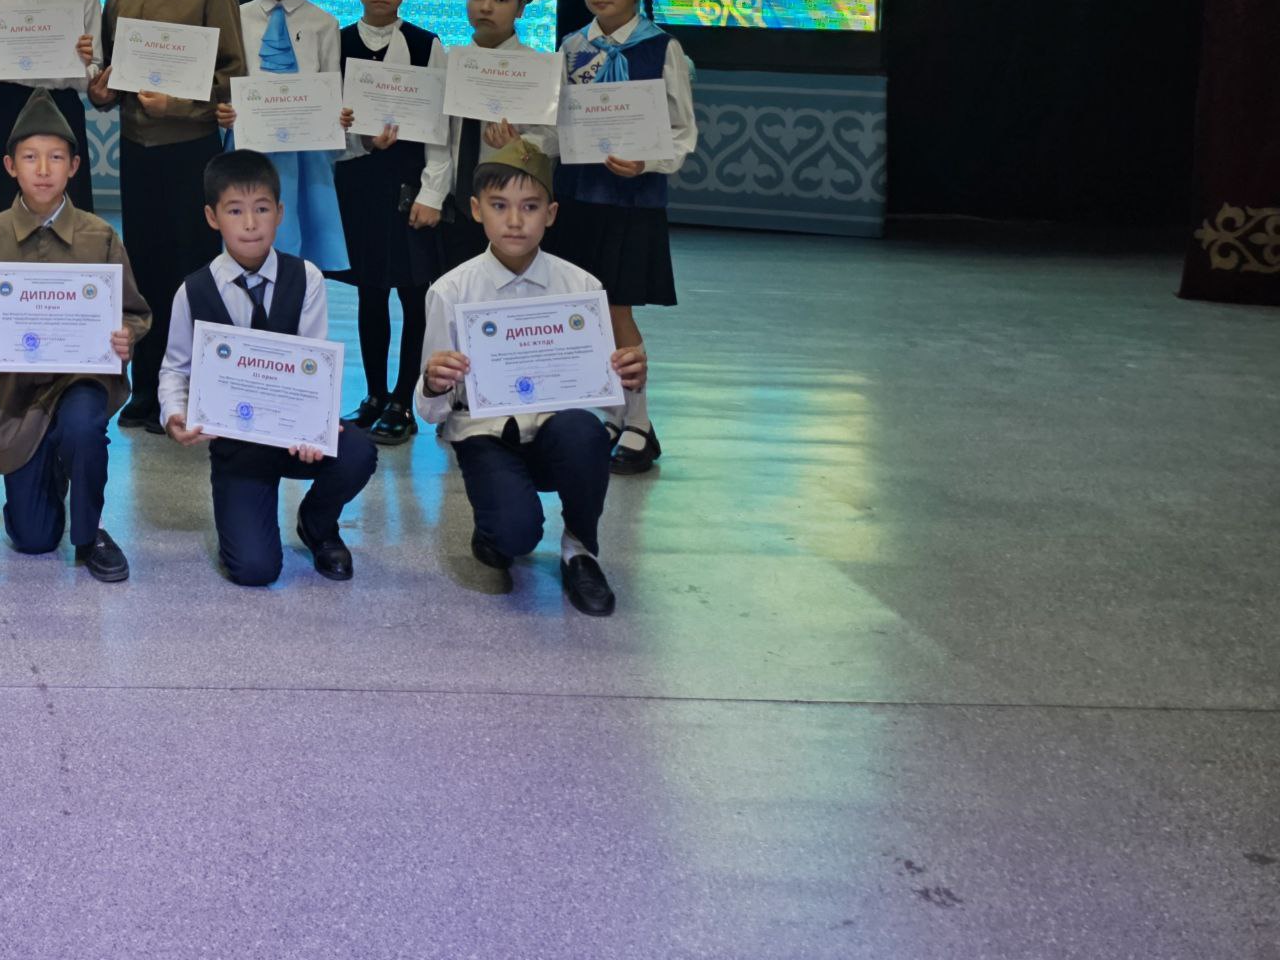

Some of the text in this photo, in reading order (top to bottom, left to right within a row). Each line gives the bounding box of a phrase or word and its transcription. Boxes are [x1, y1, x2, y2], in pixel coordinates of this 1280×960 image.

[19, 290, 77, 302] ДИПЛОМ
[505, 323, 564, 341] ДИПЛОМ
[237, 355, 295, 374] ДИПЛОМ
